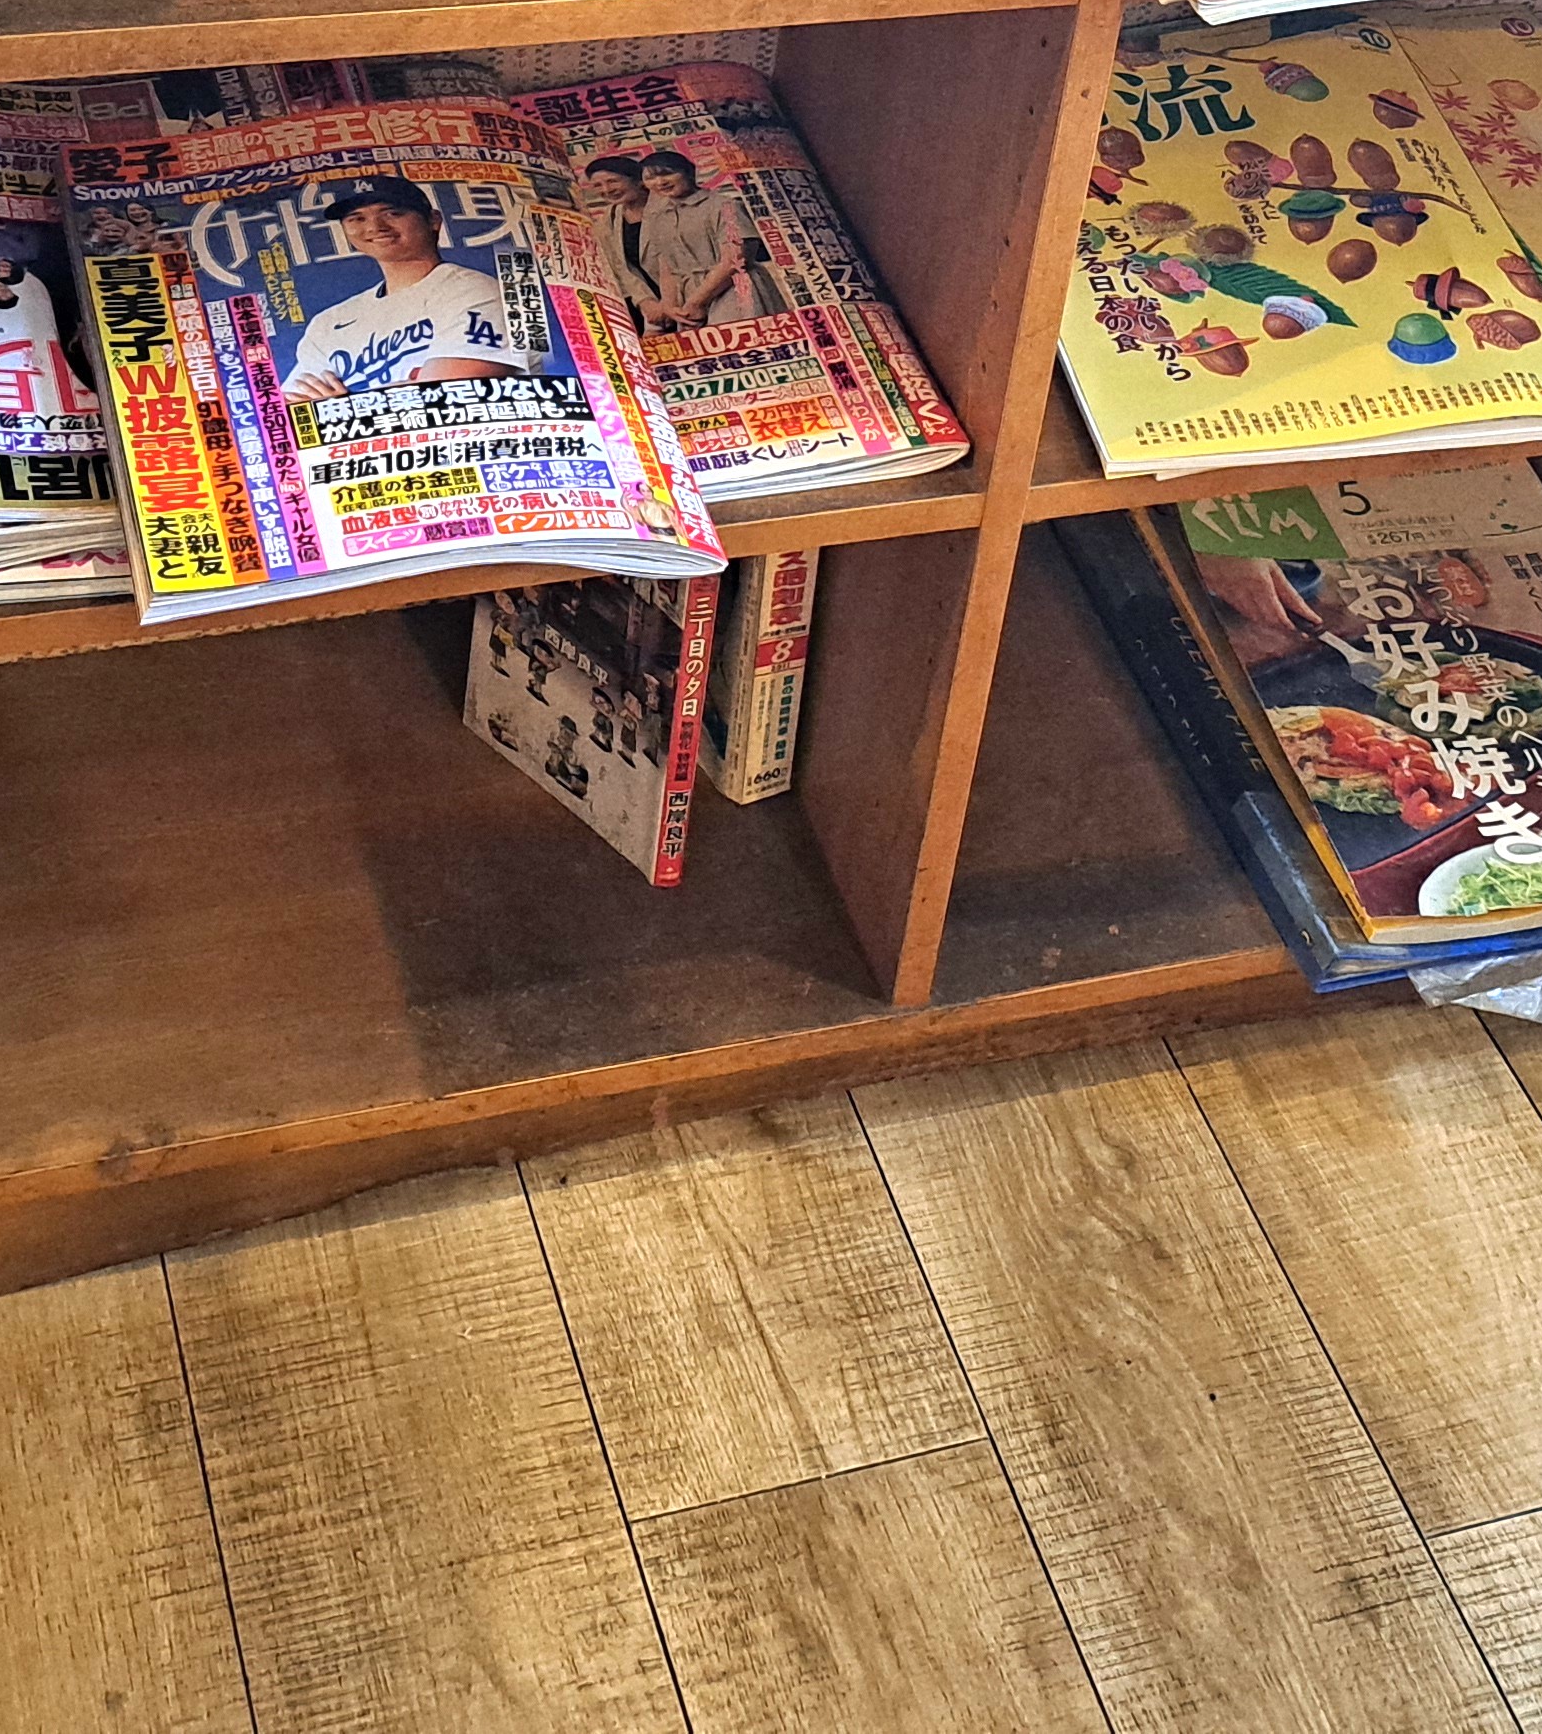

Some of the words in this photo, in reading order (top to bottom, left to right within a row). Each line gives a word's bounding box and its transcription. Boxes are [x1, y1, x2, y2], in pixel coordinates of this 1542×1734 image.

[533, 75, 684, 127] 誕生会
[67, 144, 178, 185] 愛子
[261, 105, 474, 159] 帝王修行
[73, 181, 139, 203] Snow
[142, 177, 195, 198] Man
[159, 179, 529, 288] 女性身
[92, 256, 176, 363] 真美子
[464, 310, 504, 350] LA
[315, 376, 578, 425] 麻酔薬が足りない!
[661, 363, 795, 404] 21万7700円
[118, 364, 214, 514] W披露宴
[696, 416, 727, 430] がん
[752, 413, 831, 443] 衣替え
[310, 446, 450, 486] 軍拡10兆
[453, 436, 604, 466] 消費増税へ
[688, 444, 788, 474] 眼筋ほぐし
[801, 431, 855, 455] シート
[330, 470, 452, 506] 介護のお金
[1338, 480, 1371, 517] 5
[145, 516, 188, 580] 夫妻と
[681, 596, 715, 717] 三丁目の夕日
[771, 639, 794, 664] 8
[660, 790, 690, 860] 西岸良平
